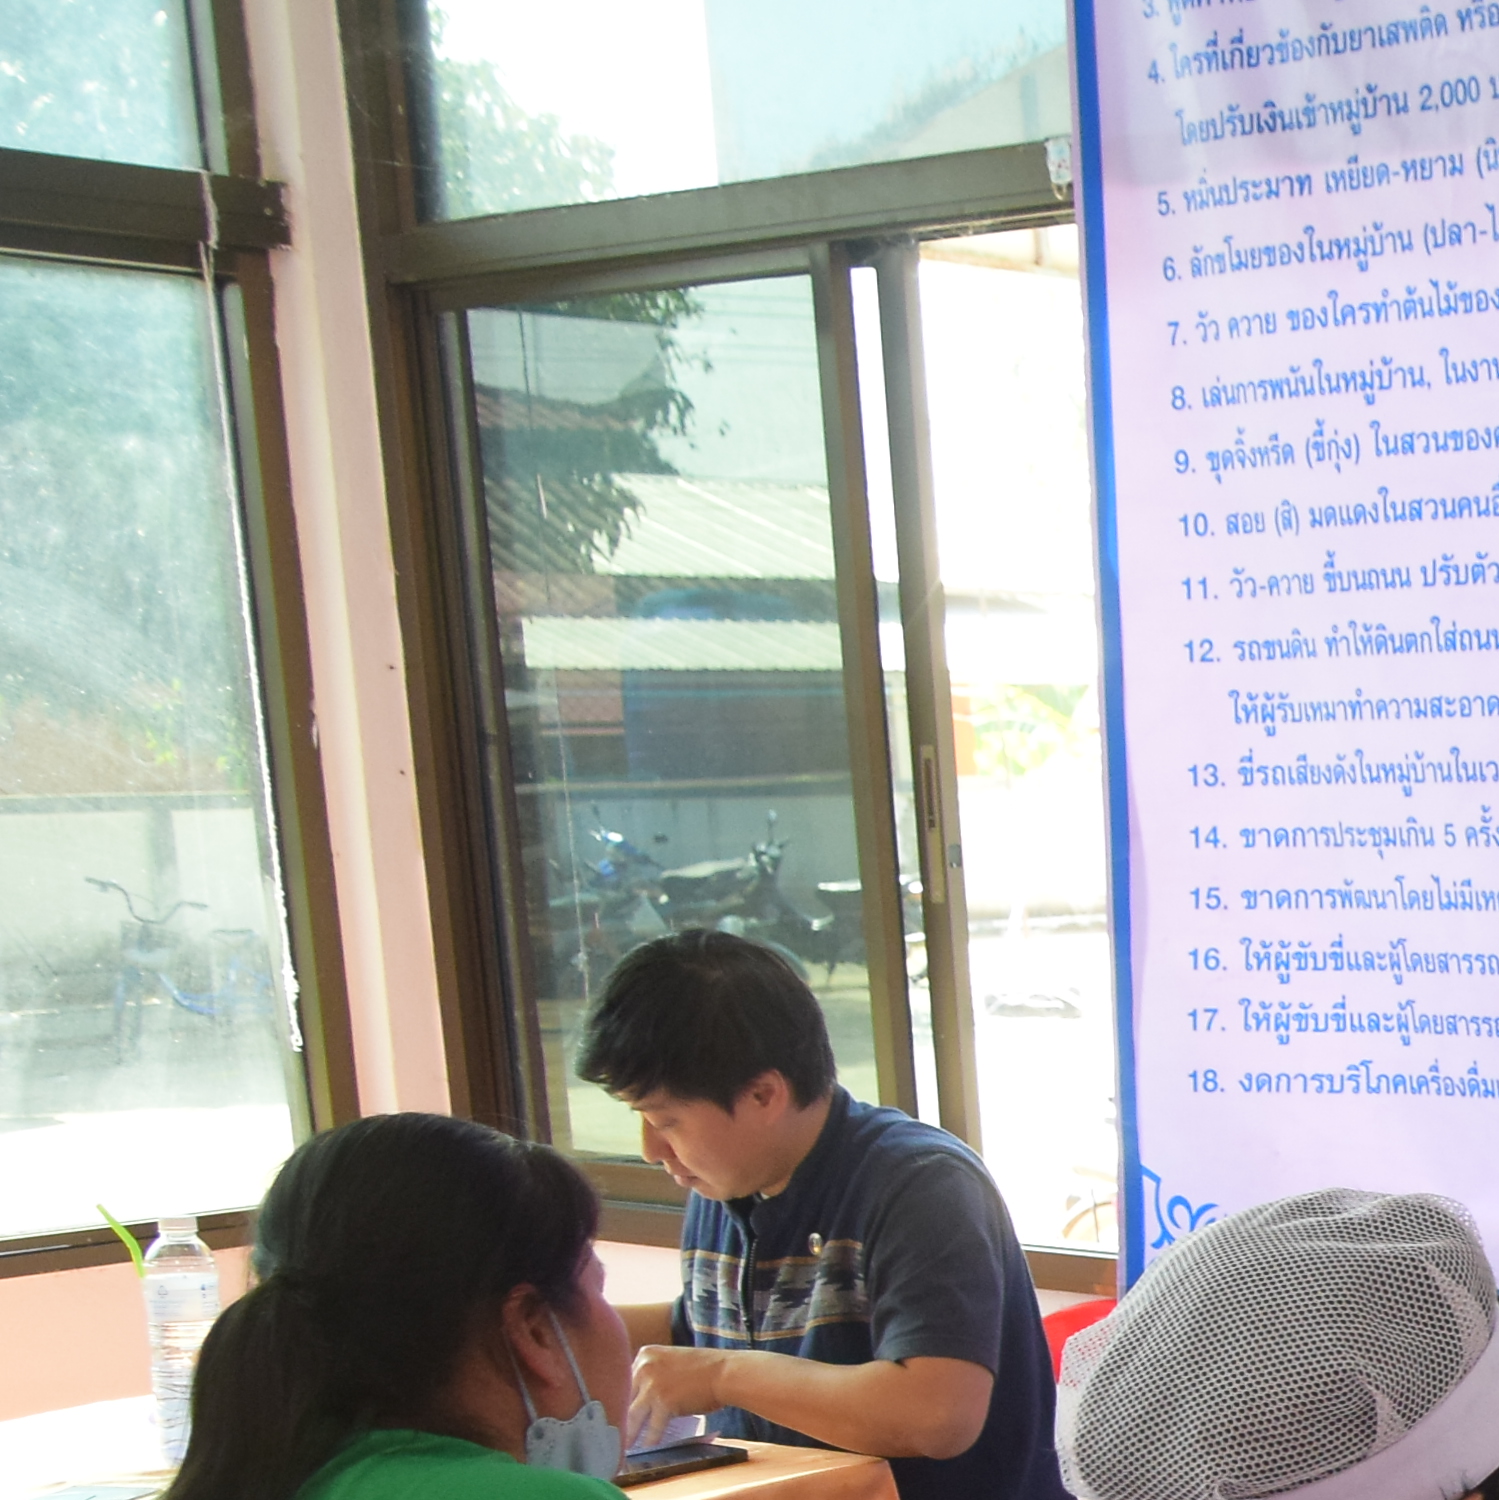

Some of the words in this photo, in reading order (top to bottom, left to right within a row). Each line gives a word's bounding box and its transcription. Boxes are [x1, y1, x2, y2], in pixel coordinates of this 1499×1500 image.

[1147, 59, 1166, 84] 4.
[1169, 4, 1449, 78] ใครที่เกี่ยวข้องกับยาเสพติด
[1174, 82, 1410, 146] โดยปรับเงินเข้าหมู่บ้าน
[1418, 74, 1481, 113] 2,000
[1157, 190, 1177, 217] 5.
[1182, 167, 1313, 212] หมิ่นประมาท
[1324, 153, 1465, 194] เหยียด-หยาม
[1162, 255, 1183, 283] 6.
[1189, 221, 1415, 279] ลักขโมยของในหมู่บ้าน
[1166, 320, 1188, 347] 7.
[1195, 310, 1221, 343] วัว
[1227, 312, 1278, 338] ควาย
[1170, 384, 1194, 411] 8.
[1201, 355, 1432, 409] เล่นการพนันในหมู่บ้าน,
[1173, 448, 1198, 475] 9.
[1205, 426, 1296, 485] ขุดจิ้งหรีด
[1178, 511, 1216, 538] 10.
[1225, 512, 1266, 536] สอย
[1181, 576, 1220, 601] 11.
[1229, 567, 1315, 599] วัว-ควาย
[1322, 549, 1413, 594] ขี้บนถนน
[1183, 637, 1222, 664] 12.
[1232, 627, 1318, 662] รถขนดิน
[1187, 762, 1226, 788] 13.
[1189, 825, 1229, 849] 14.
[1238, 815, 1436, 860] ขาดการประชุมเกิน
[1443, 822, 1457, 848] 5
[1189, 886, 1230, 911] 15.
[1188, 946, 1229, 972] 16.
[1187, 1007, 1226, 1032] 17.
[1187, 1068, 1225, 1094] 18.
